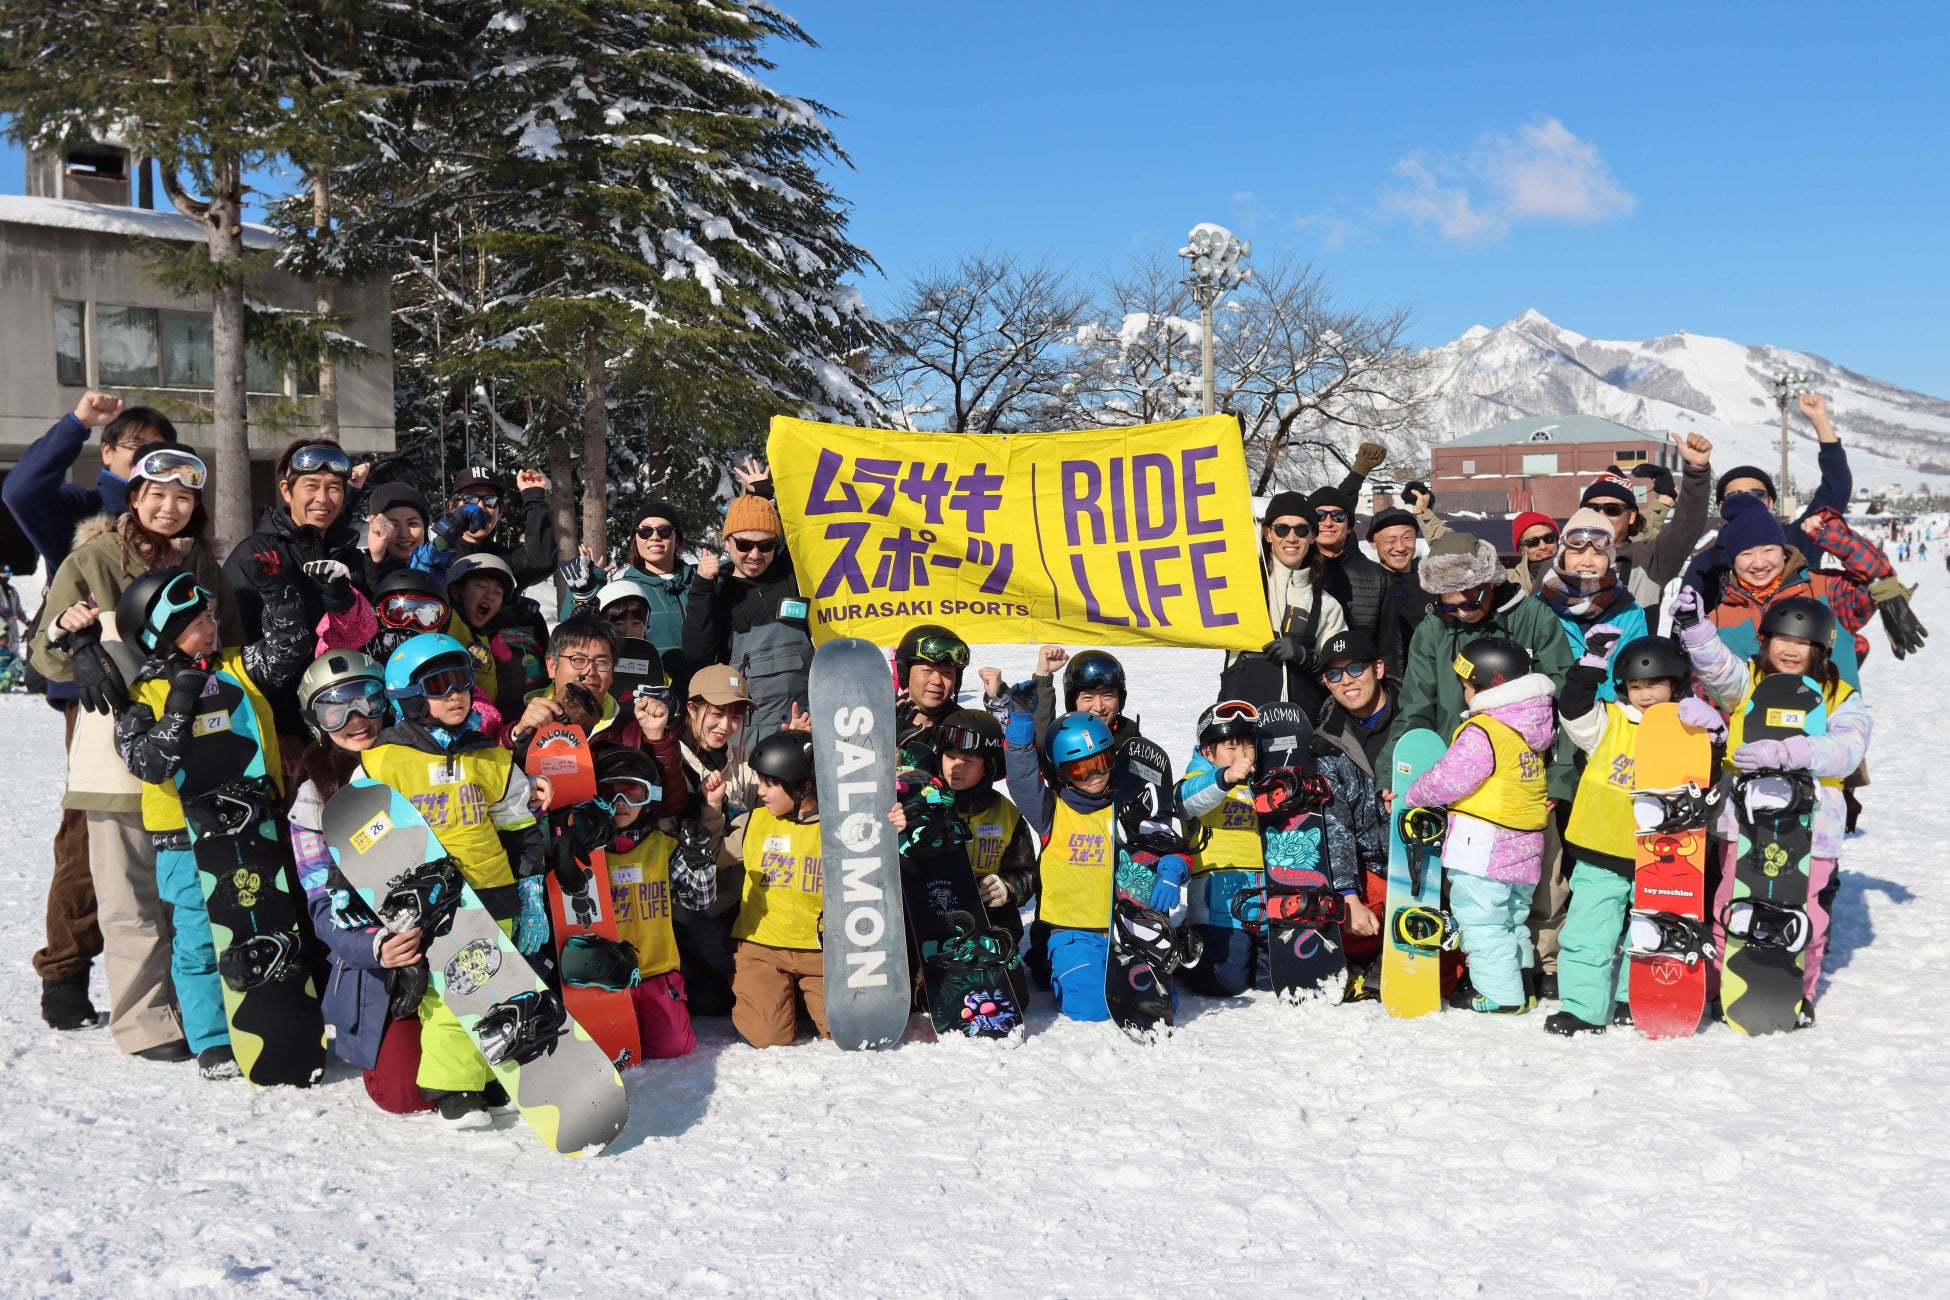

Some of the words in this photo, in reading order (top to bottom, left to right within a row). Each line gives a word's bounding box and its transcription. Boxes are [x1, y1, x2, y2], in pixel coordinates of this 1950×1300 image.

[804, 447, 1004, 534] ムラサキ
[1061, 445, 1225, 547] RIDE
[815, 521, 1013, 599] スポーツ
[1069, 539, 1239, 629] LIFE
[817, 600, 933, 625] MURASAKI
[940, 599, 1030, 617] SPORTS
[207, 716, 221, 729] 27
[1257, 707, 1300, 728] SALOMON
[1786, 714, 1798, 723] 23
[536, 729, 581, 749] SALOMON
[1128, 741, 1168, 772] SALOMON
[410, 791, 449, 811] ラサキ
[459, 782, 487, 805] RID
[461, 803, 488, 825] LIF
[371, 821, 384, 836] 26
[834, 706, 888, 989] SALOMON
[1068, 833, 1105, 848] ムラサキ
[760, 852, 796, 870] ムラサキ
[1068, 847, 1105, 862] スポーツ
[804, 856, 823, 875] RID
[760, 868, 796, 884] スポーツ
[802, 874, 823, 894] LIF
[639, 880, 668, 901] RIDE
[1644, 887, 1658, 896] toy
[1658, 889, 1694, 897] machine
[640, 899, 670, 921] LIFE
